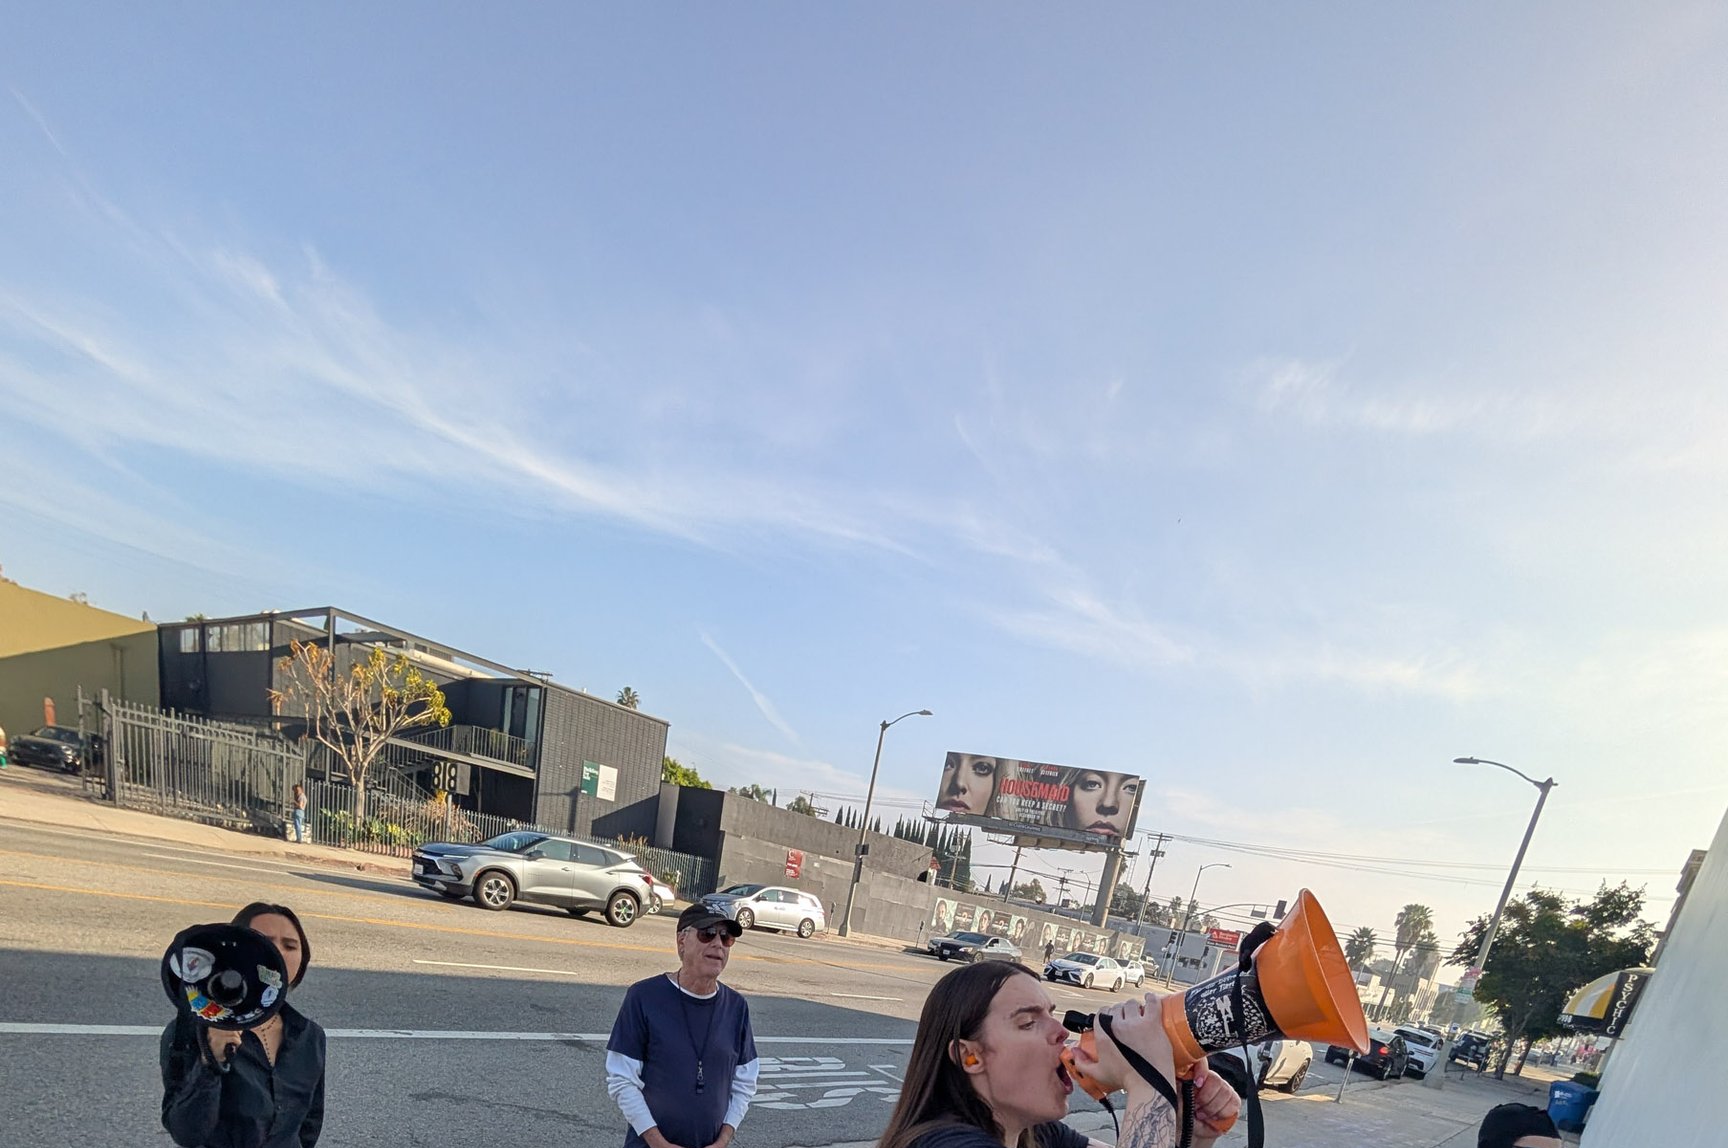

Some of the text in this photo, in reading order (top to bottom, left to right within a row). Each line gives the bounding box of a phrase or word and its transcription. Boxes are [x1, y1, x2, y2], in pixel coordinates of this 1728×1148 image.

[432, 761, 457, 792] 818
[999, 776, 1070, 802] HOUSEMAID
[1021, 799, 1035, 809] KEEP
[1606, 974, 1638, 1035] PSYCHIC
